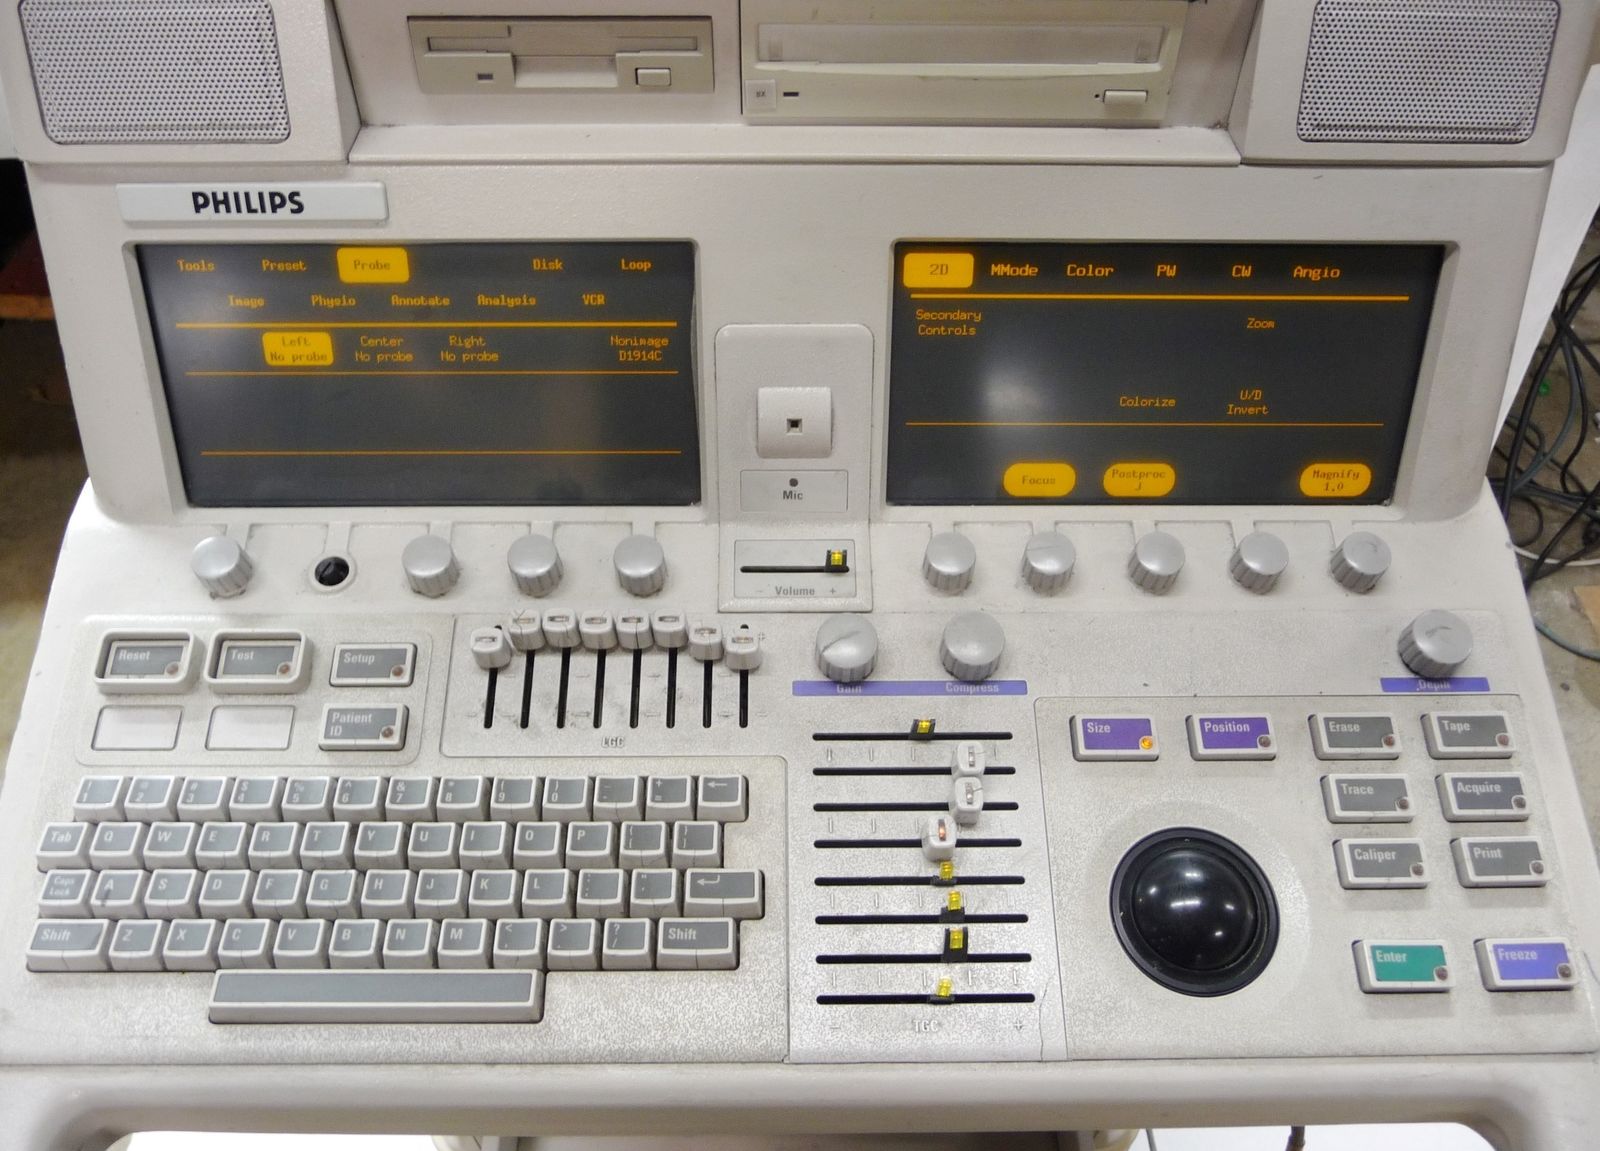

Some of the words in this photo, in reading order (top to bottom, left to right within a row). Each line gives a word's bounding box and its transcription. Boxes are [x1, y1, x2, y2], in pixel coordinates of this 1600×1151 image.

[191, 191, 305, 214] PHILIPS
[177, 259, 215, 272] Tools
[262, 259, 307, 272] Preset
[353, 259, 390, 271] Probe
[532, 259, 564, 271] Disk
[621, 259, 652, 273] Loop
[929, 263, 949, 276] 2D
[991, 264, 1039, 277] MMode
[1066, 264, 1115, 277] Color
[1156, 264, 1177, 278] PW
[1231, 265, 1252, 278] CW
[1293, 265, 1341, 281] Angio
[228, 295, 265, 308] Image
[311, 295, 356, 308] Physio
[391, 295, 451, 306] Annotate
[477, 294, 537, 308] Analysis
[582, 294, 606, 306] VCR
[916, 309, 982, 322] Secondary
[1246, 317, 1275, 329] Zoom
[918, 324, 977, 336] Controls
[281, 336, 311, 347] Left
[360, 336, 404, 347] Center
[449, 335, 487, 348] Right
[610, 335, 669, 348] Nonimage
[270, 351, 286, 362] No
[291, 352, 328, 364] probe
[355, 352, 370, 362] No
[377, 352, 414, 364] probe
[441, 351, 456, 361] No
[462, 351, 499, 363] probe
[619, 350, 662, 361] D1914C
[1240, 389, 1262, 400] U/D
[1119, 396, 1176, 408] Colorize
[1227, 404, 1270, 415] Invert
[1022, 475, 1056, 485] Focus
[1111, 468, 1166, 480] Postproc
[1312, 469, 1360, 481] Magnify
[1324, 482, 1344, 492] 1.0
[783, 489, 803, 501] Mic
[775, 585, 816, 597] Volume
[119, 650, 151, 661] Reset
[231, 650, 254, 661] Test
[344, 652, 375, 666] Setup
[945, 682, 999, 695] Compress
[331, 712, 373, 724] Patient
[330, 725, 343, 737] ID
[1087, 721, 1111, 734] Size
[1204, 721, 1250, 734] Position
[1329, 720, 1360, 733] Erase
[1442, 720, 1471, 733] Tape
[1341, 783, 1374, 795] Trace
[1457, 782, 1502, 795] Acquire
[396, 793, 403, 803] 7
[445, 793, 452, 802] 8
[499, 792, 505, 802] 9
[50, 831, 71, 842] Tab
[104, 831, 114, 843] Q
[158, 831, 172, 842] W
[209, 831, 218, 842] E
[261, 831, 270, 842] R
[313, 830, 321, 841] T
[367, 830, 376, 841] Y
[420, 831, 429, 842] U
[525, 830, 534, 841] O
[577, 830, 586, 841] P
[1354, 848, 1397, 862] Caliper
[1473, 847, 1503, 859] Print
[104, 878, 114, 891] A
[158, 879, 168, 890] S
[212, 879, 222, 890] D
[266, 879, 274, 890] F
[320, 879, 329, 891] G
[374, 879, 384, 890] H
[426, 879, 435, 890] J
[480, 879, 489, 890] K
[533, 878, 541, 889] L
[41, 928, 71, 942] Shift
[122, 930, 133, 941] Z
[176, 930, 187, 941] X
[232, 929, 241, 941] C
[287, 929, 296, 940] V
[342, 929, 351, 940] B
[395, 929, 406, 940] N
[450, 929, 463, 940] M
[668, 927, 697, 941] Shift
[1375, 950, 1407, 963] Enter
[1498, 949, 1538, 961] Freeze
[913, 1019, 939, 1033] TGC
